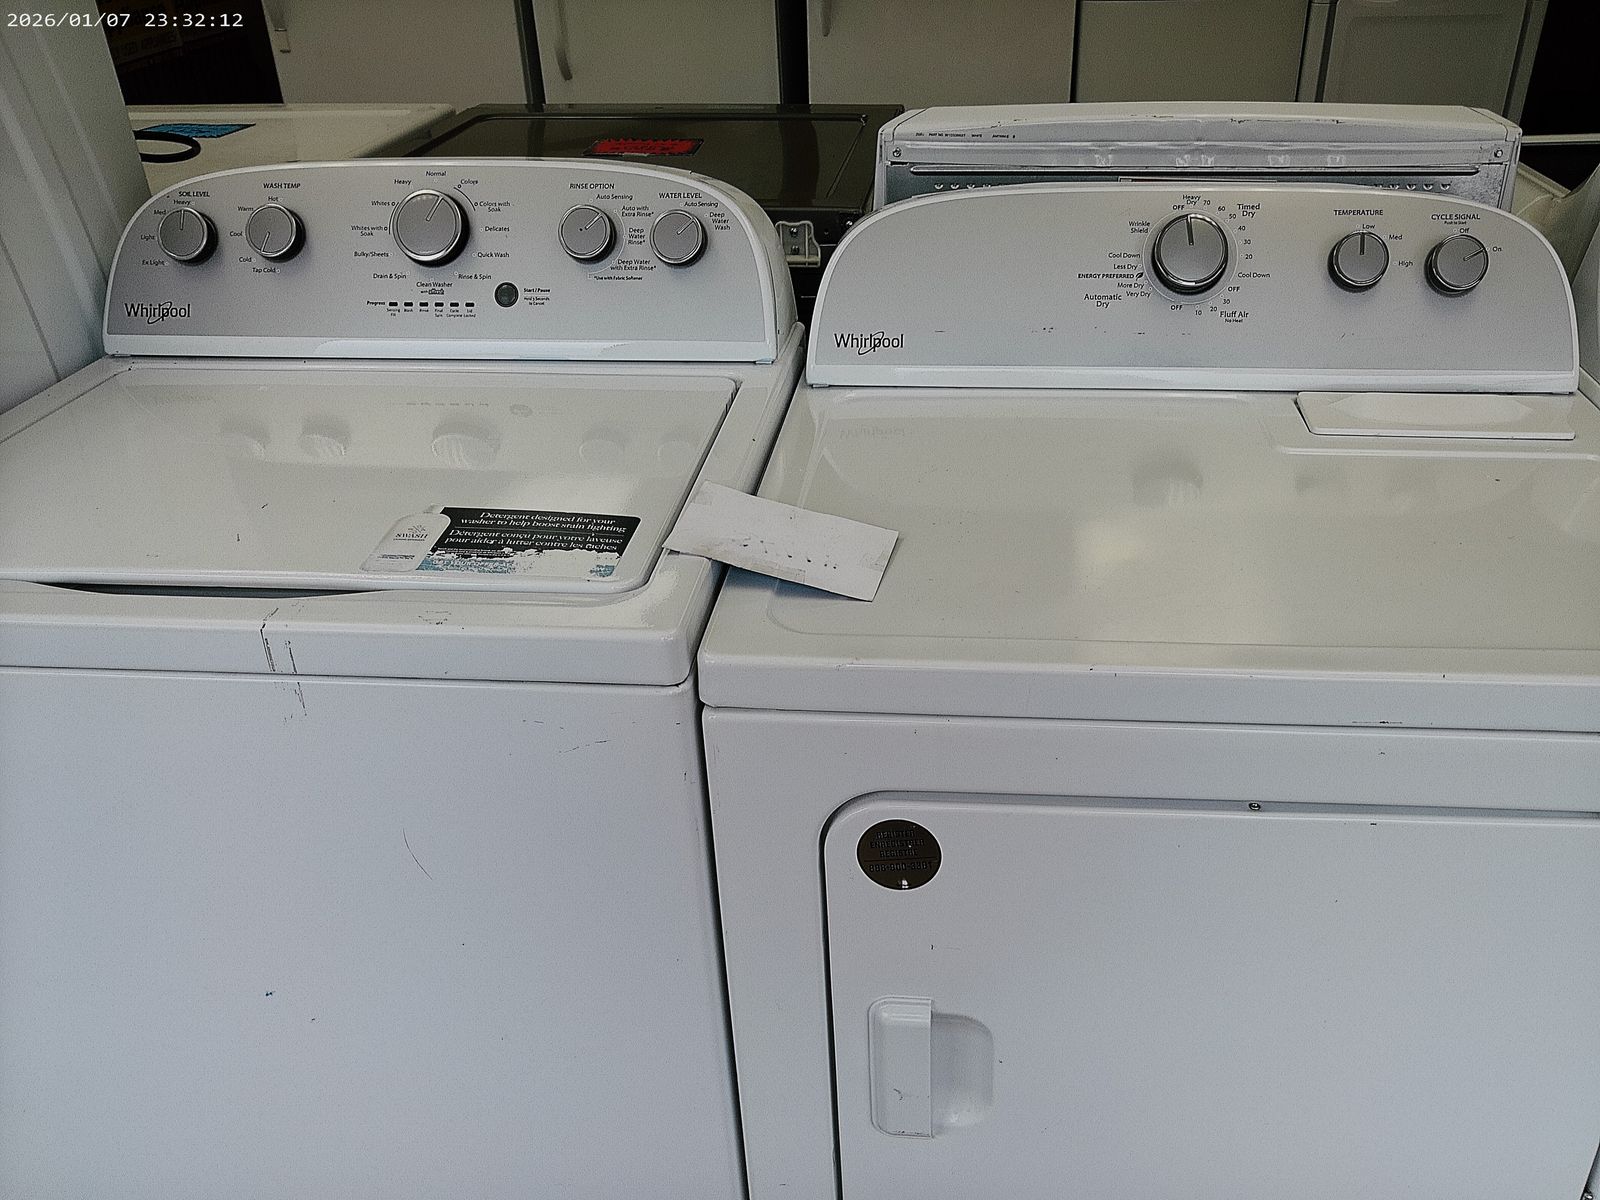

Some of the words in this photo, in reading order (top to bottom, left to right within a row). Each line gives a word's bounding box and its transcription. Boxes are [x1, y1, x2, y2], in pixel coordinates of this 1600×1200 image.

[125, 302, 191, 323] Whirlpool
[834, 332, 904, 355] Whirlpool
[480, 512, 531, 520] Detergent
[586, 524, 627, 533] fighting
